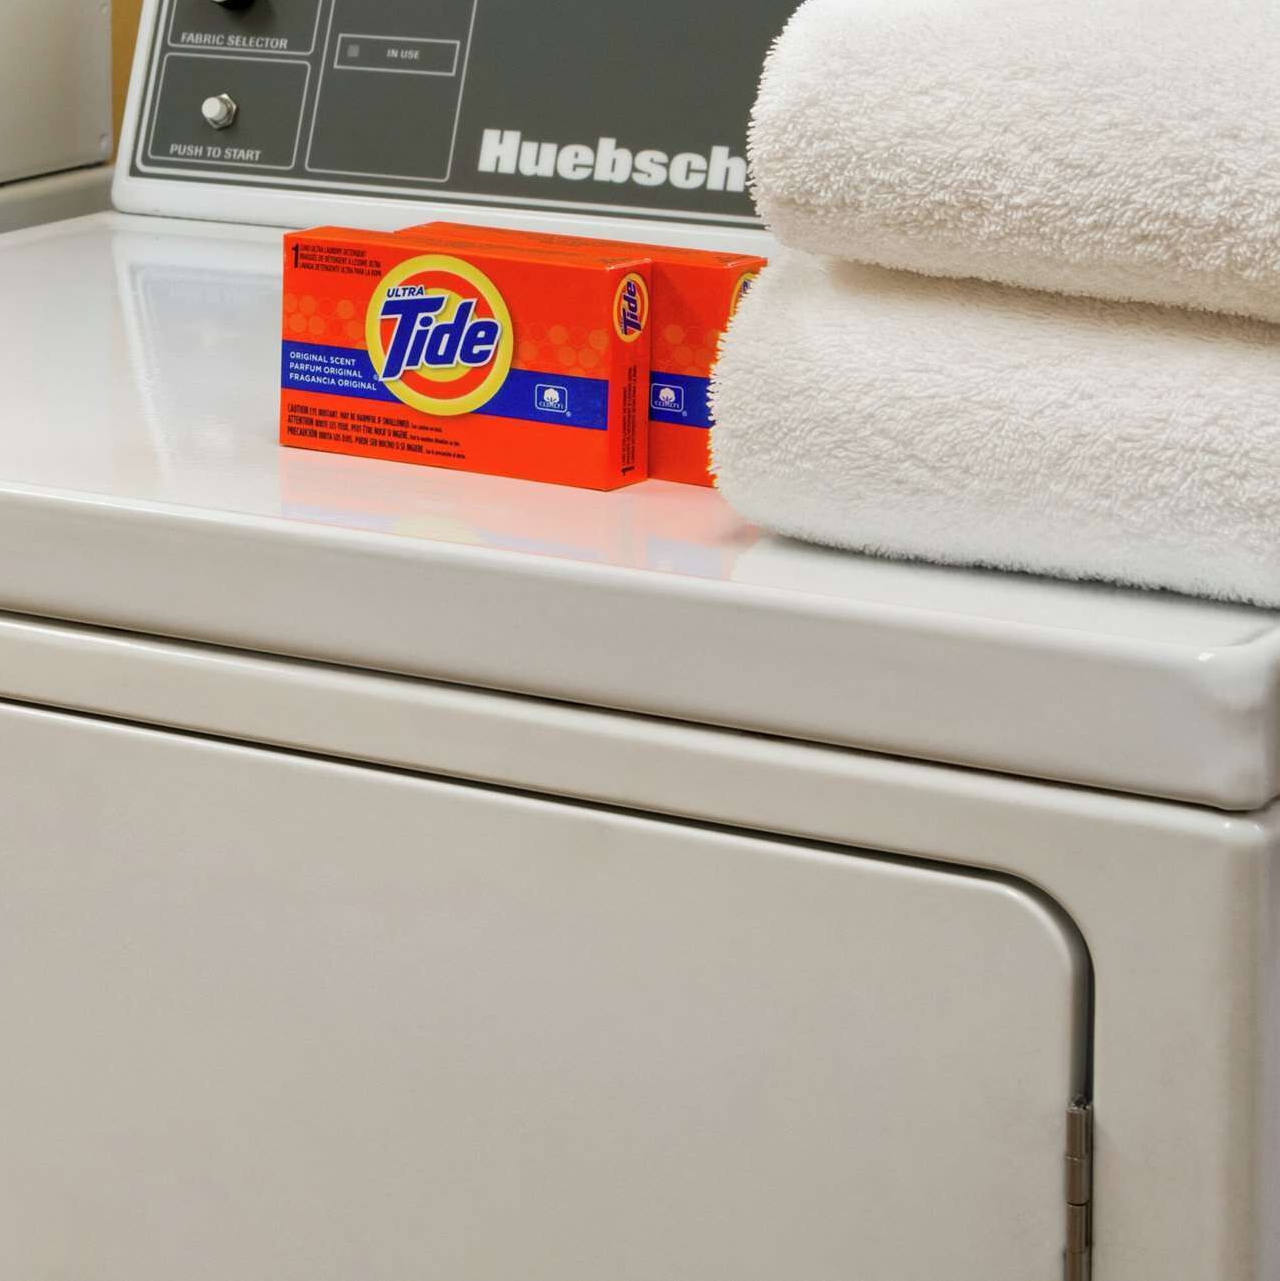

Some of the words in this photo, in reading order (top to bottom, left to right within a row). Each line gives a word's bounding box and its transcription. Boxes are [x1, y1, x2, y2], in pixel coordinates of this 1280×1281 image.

[181, 32, 224, 46] FABRIC
[226, 34, 288, 49] SELECTOR
[387, 48, 398, 58] IN
[400, 50, 420, 60] USE
[169, 143, 204, 157] PUSH
[206, 146, 222, 159] TO
[224, 148, 262, 162] START
[478, 129, 747, 192] Huebsch
[386, 287, 424, 298] ULTRA
[621, 280, 642, 336] Tide
[379, 295, 501, 381] Tide
[289, 351, 328, 363] ORIGINAL
[329, 356, 357, 366] SCENT
[289, 362, 322, 373] PARFUM
[323, 366, 363, 379] ORIGINAL
[289, 372, 337, 386] FRAGANCIA
[337, 380, 377, 391] ORIGINAL
